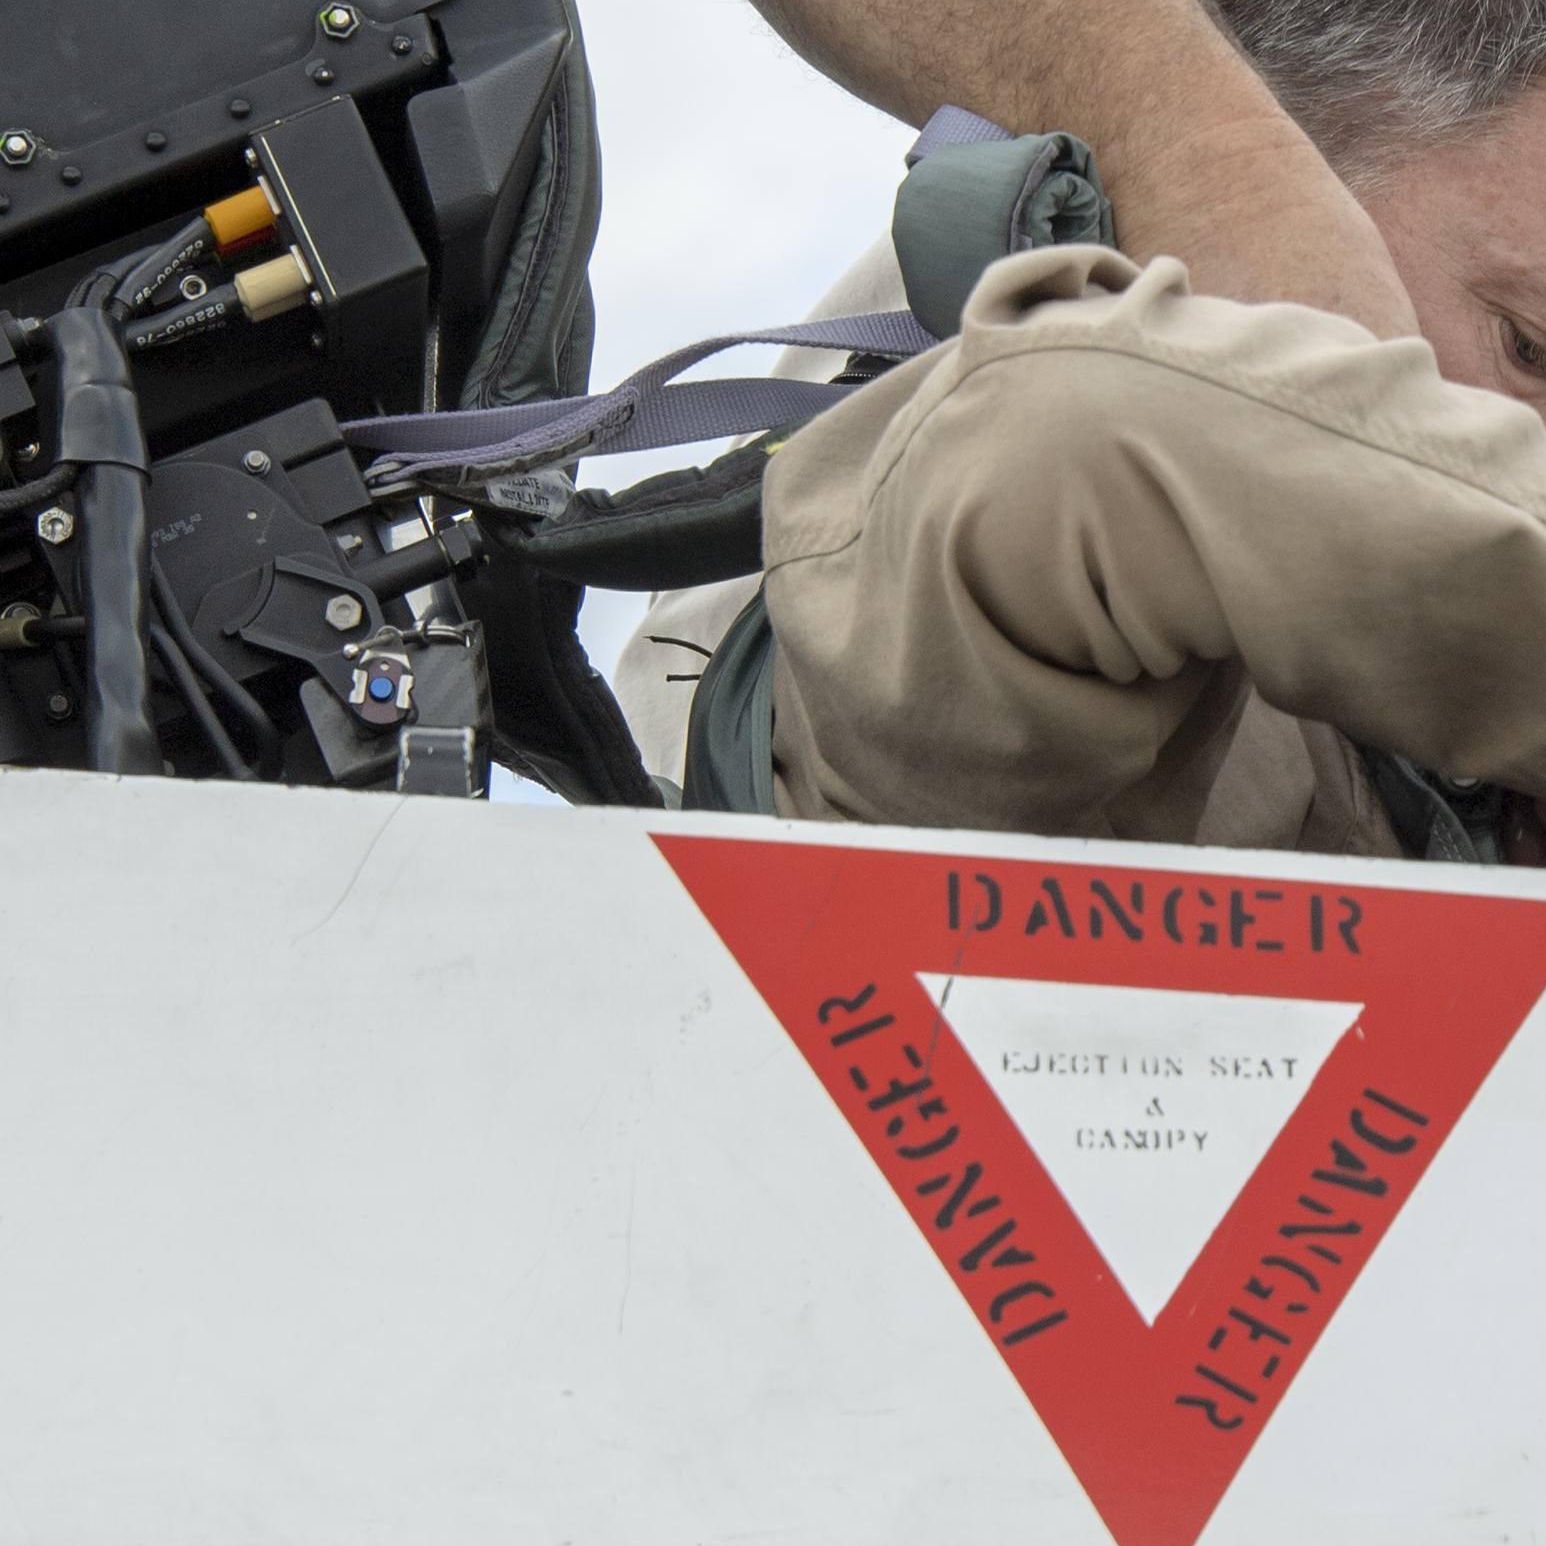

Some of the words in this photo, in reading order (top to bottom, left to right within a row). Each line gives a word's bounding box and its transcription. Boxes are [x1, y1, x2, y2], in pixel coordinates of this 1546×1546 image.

[136, 302, 227, 346] 822860-76
[947, 869, 1365, 956] DANGER
[1002, 1050, 1184, 1078] EJECTION
[1208, 1055, 1299, 1080] SEAT
[1145, 1095, 1165, 1118] &
[1075, 1127, 1210, 1152] CANOPY
[817, 981, 1069, 1346] DANGER
[1175, 1087, 1430, 1431] DANGER
